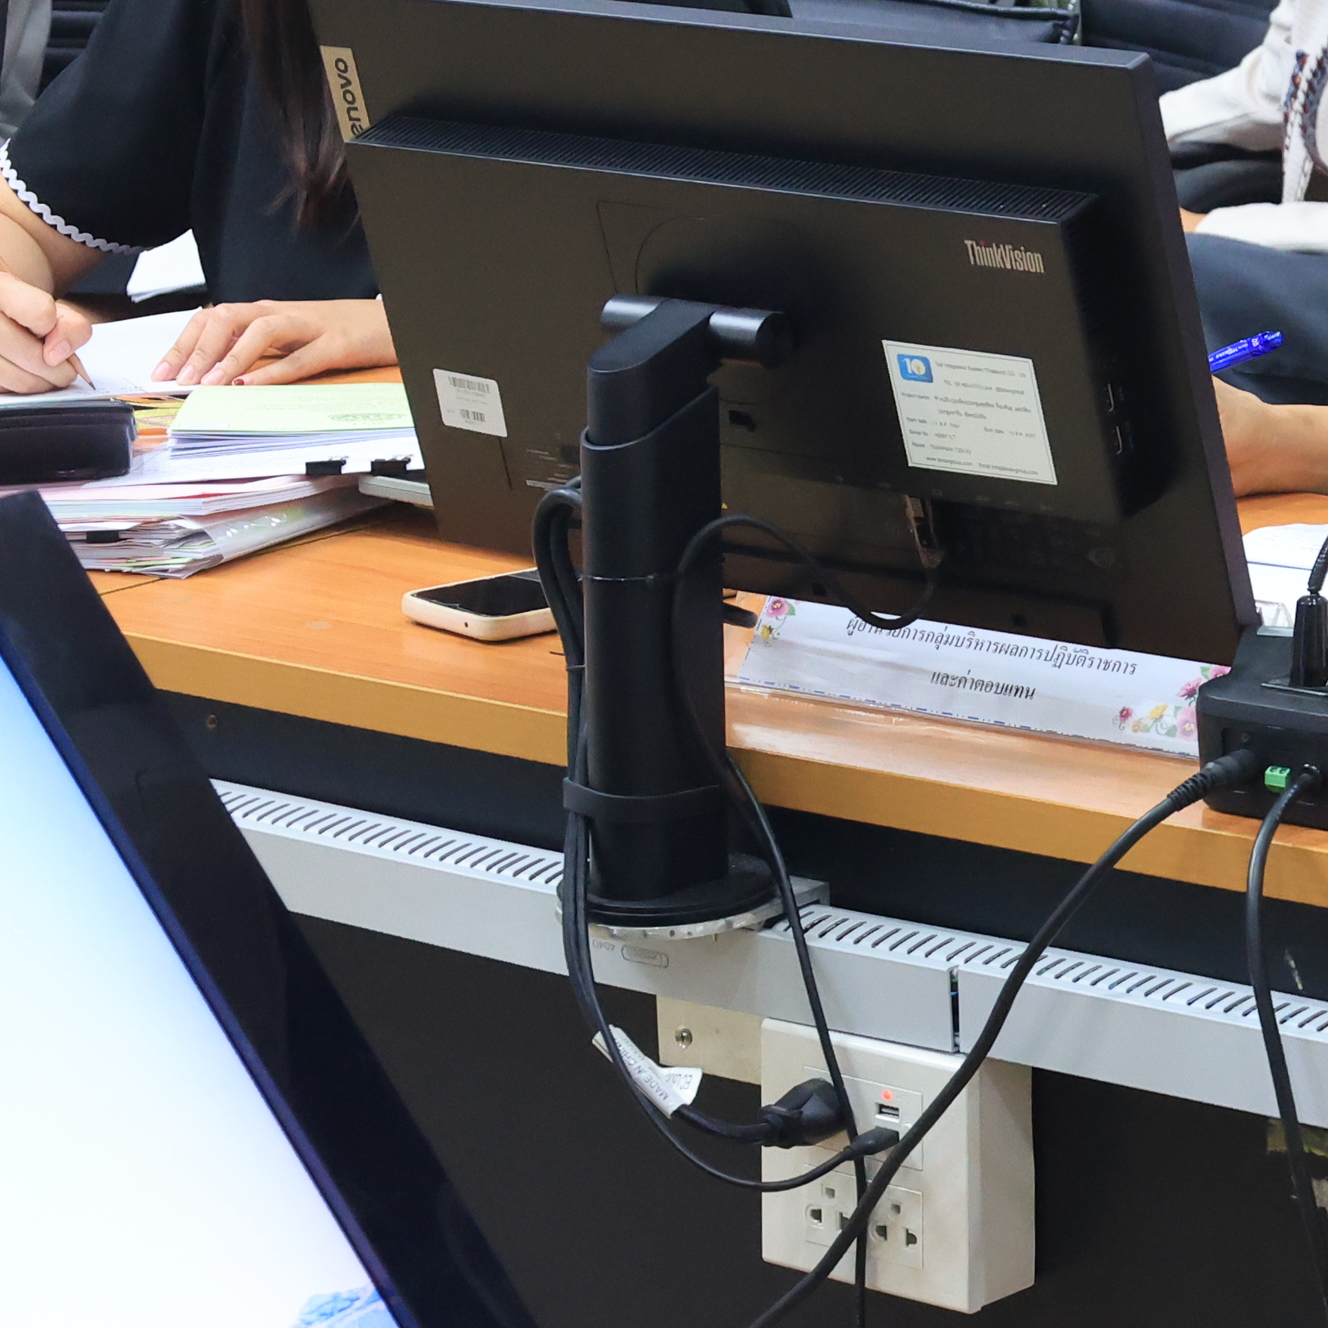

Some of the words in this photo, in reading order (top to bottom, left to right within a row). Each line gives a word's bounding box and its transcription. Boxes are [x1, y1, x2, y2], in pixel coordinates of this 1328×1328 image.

[335, 58, 364, 136] enovo
[964, 239, 1045, 274] ThinkVision
[846, 615, 1138, 675] ผูอนวยการกลุ่มบริหารผลการปฏิบัติราชการ
[930, 669, 1036, 700] และค่าตอบแทน
[644, 1075, 671, 1101] MADE
